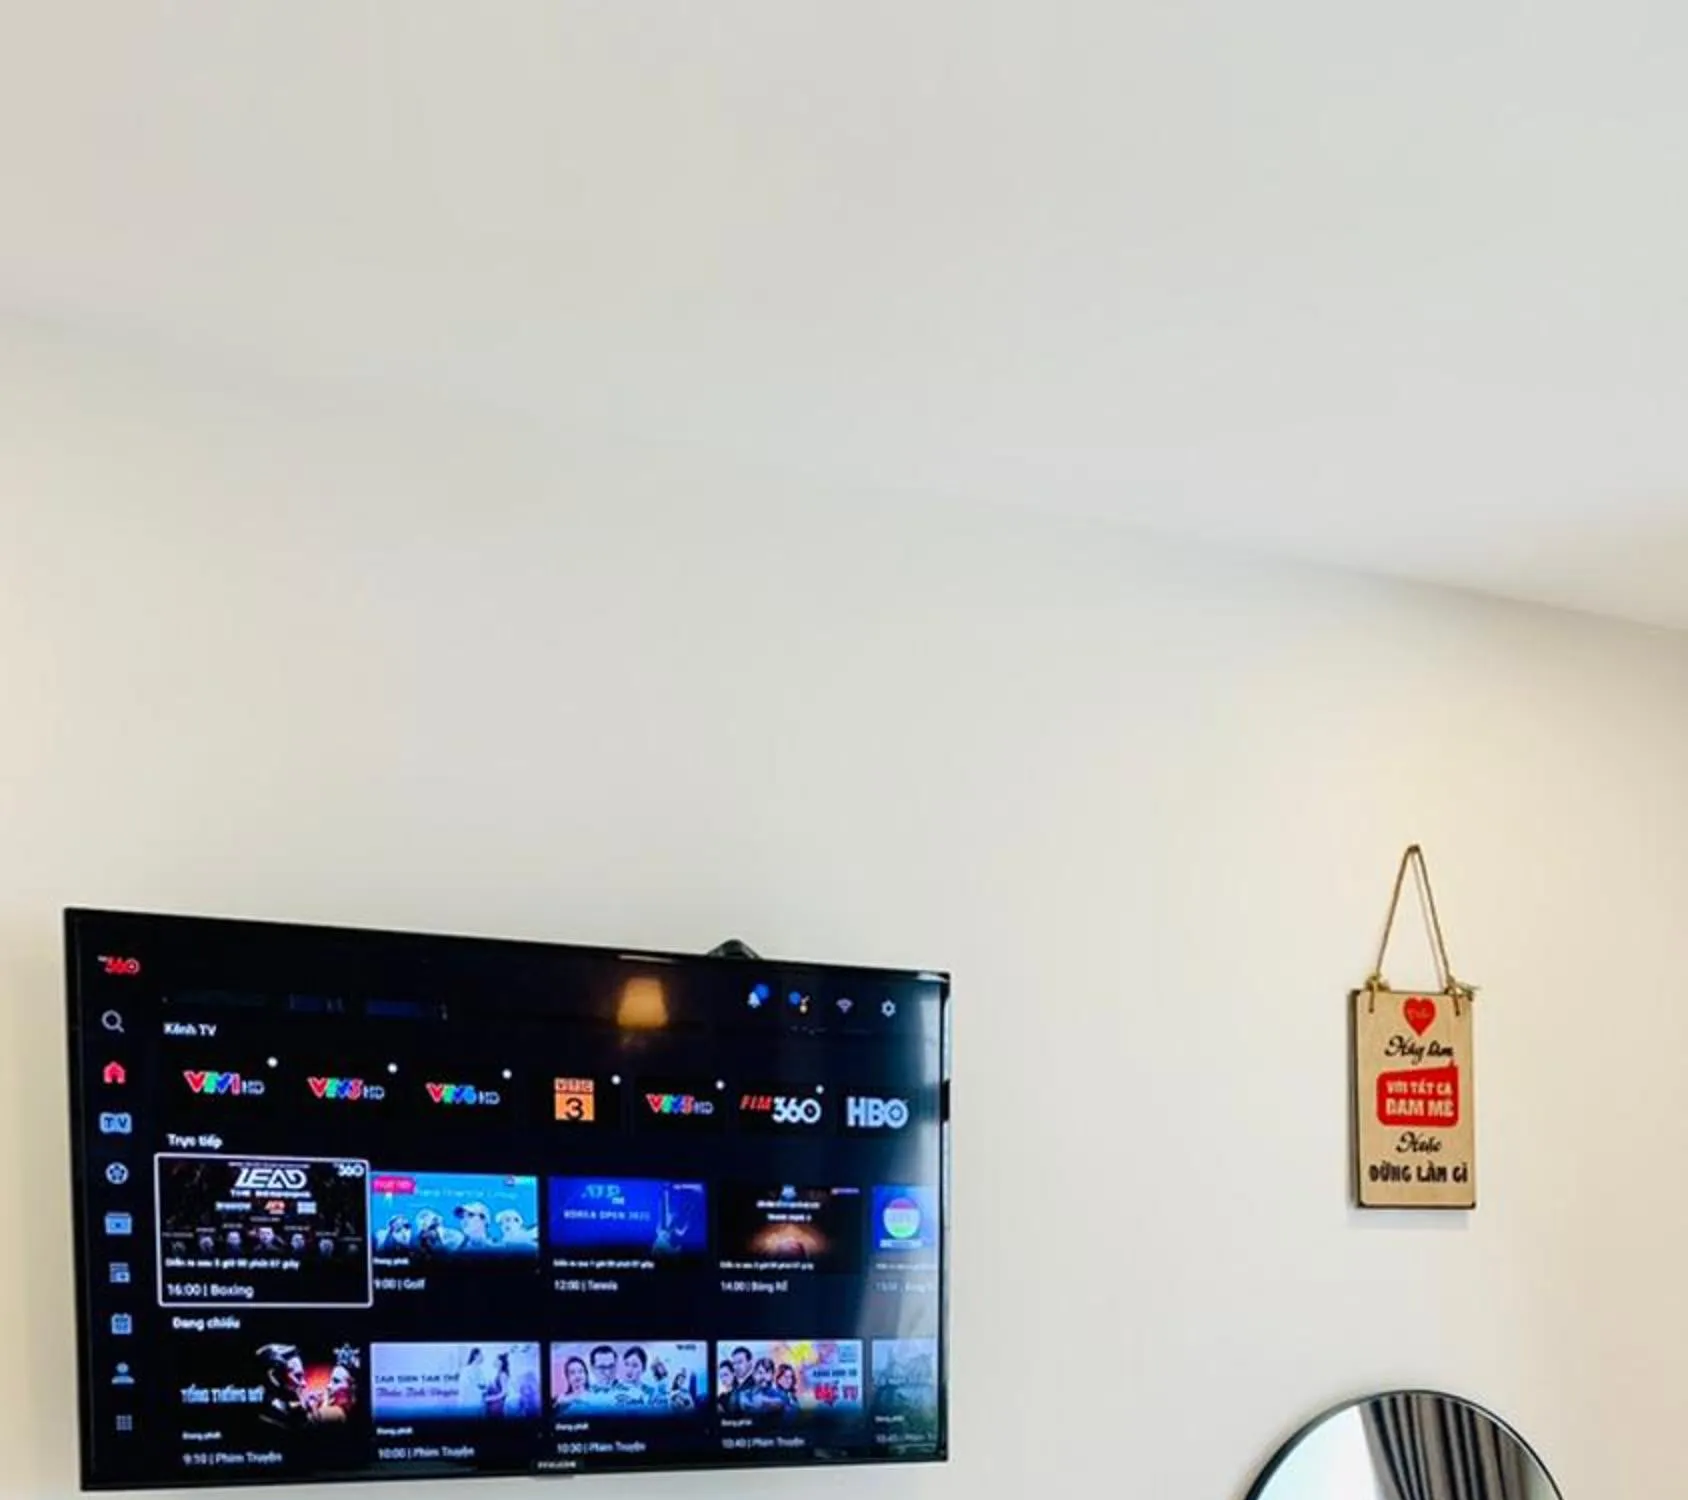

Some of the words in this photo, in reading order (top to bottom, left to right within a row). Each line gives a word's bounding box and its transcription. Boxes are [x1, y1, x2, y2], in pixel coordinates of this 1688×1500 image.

[198, 1023, 217, 1036] TV
[846, 1096, 909, 1129] HBO
[234, 1168, 308, 1189] LEAD
[210, 1284, 254, 1299] Boxing
[403, 1278, 426, 1290] Golf
